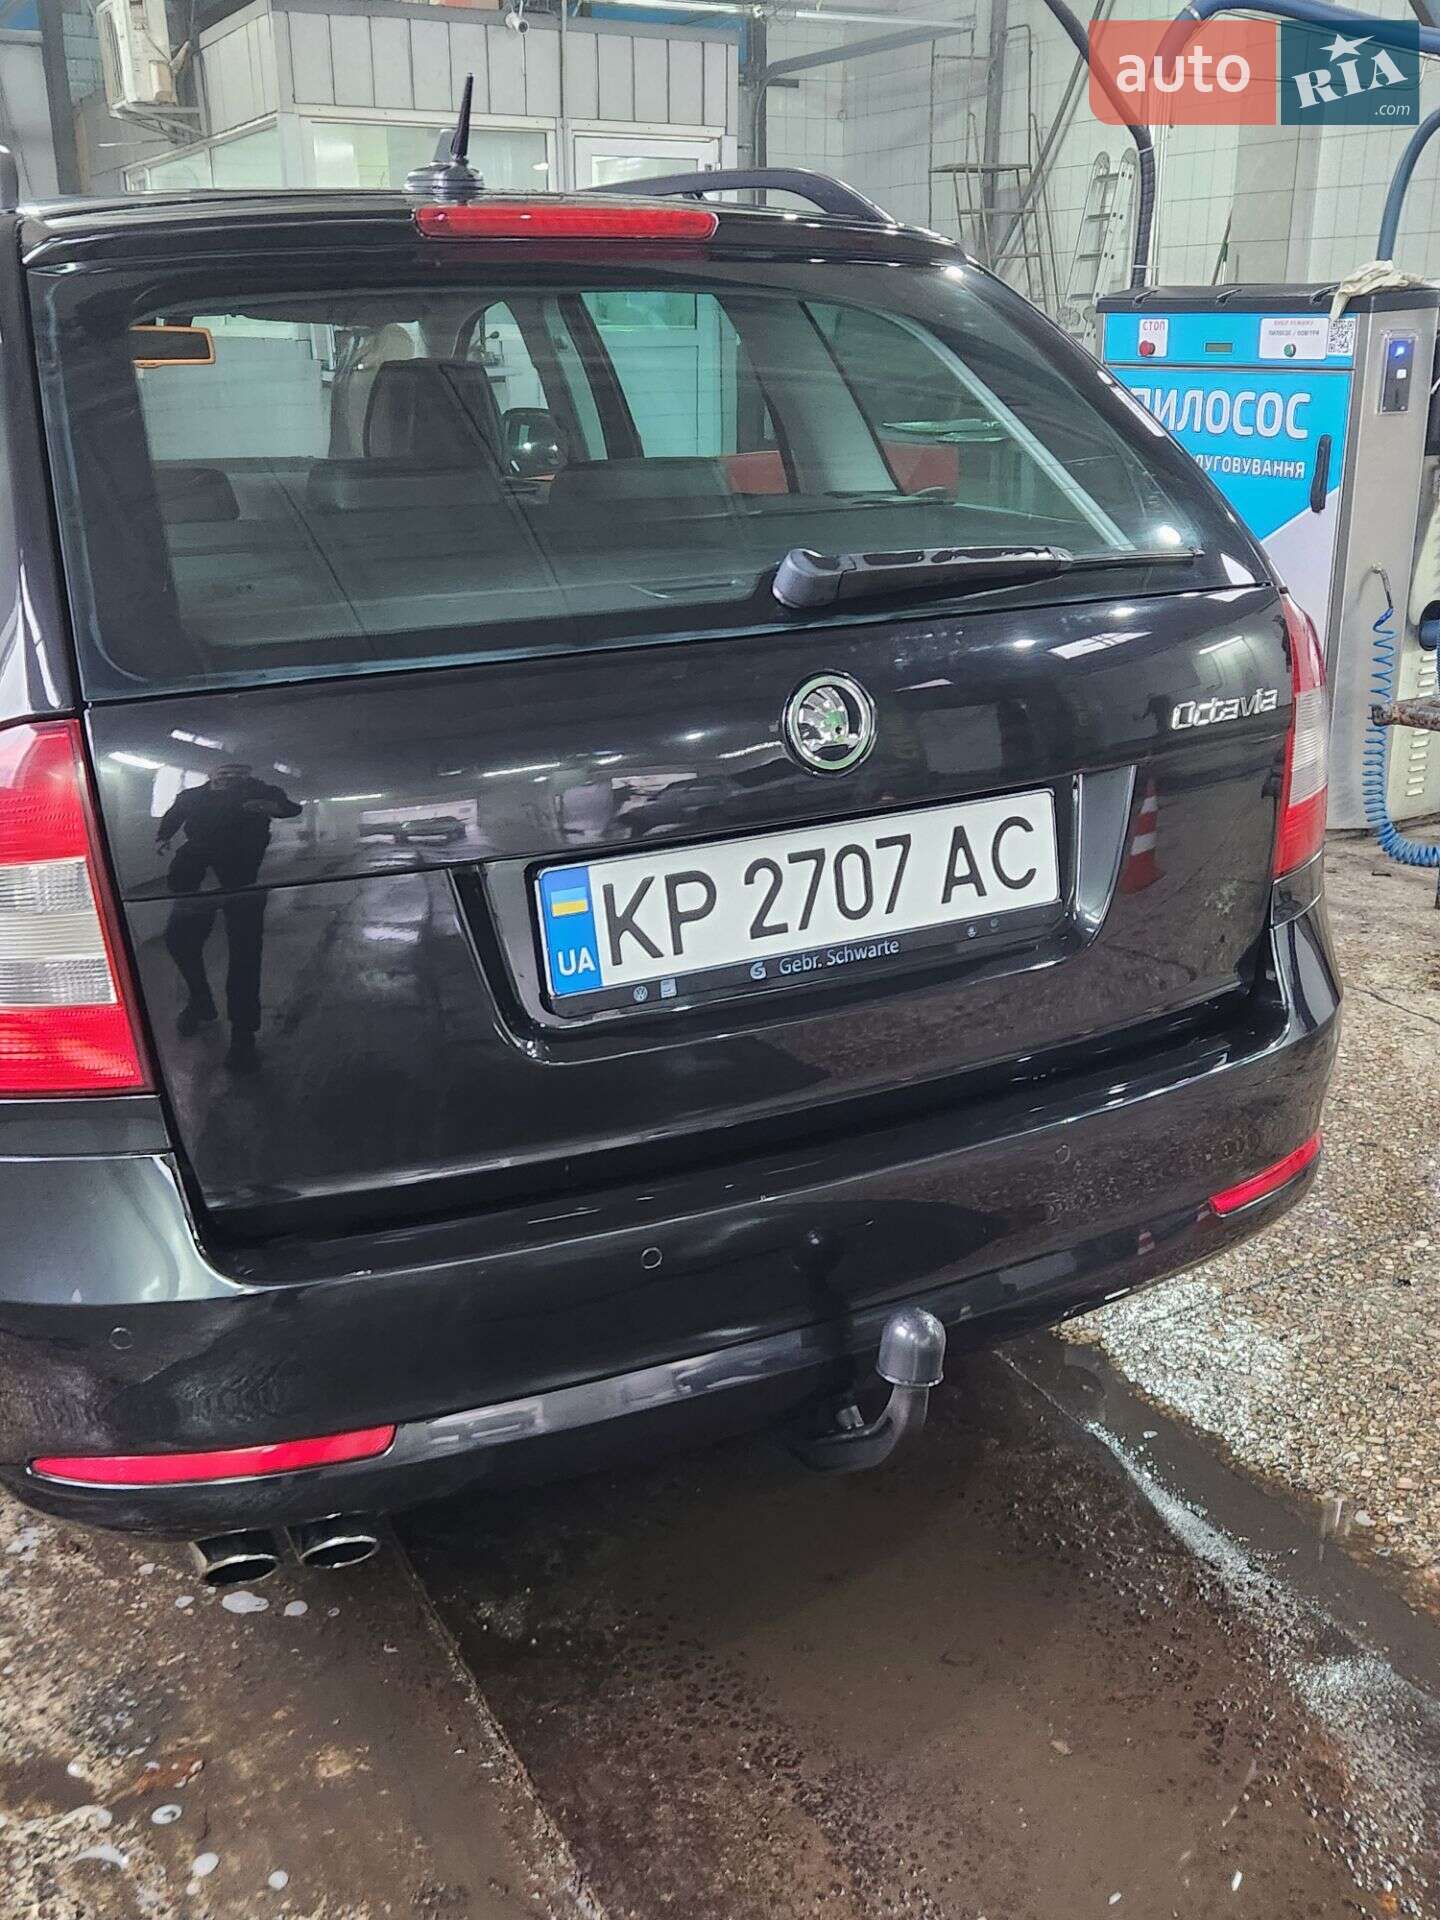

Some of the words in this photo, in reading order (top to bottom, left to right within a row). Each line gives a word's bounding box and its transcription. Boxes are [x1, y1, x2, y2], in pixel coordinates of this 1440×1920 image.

[1142, 320, 1166, 331] СТОП
[1171, 687, 1279, 730] Octavia
[601, 869, 718, 967] KP
[743, 833, 912, 940] 2707
[940, 816, 1038, 905] AC
[557, 949, 597, 977] UA
[778, 953, 823, 976] Gebr.
[826, 938, 900, 968] Schwarte
